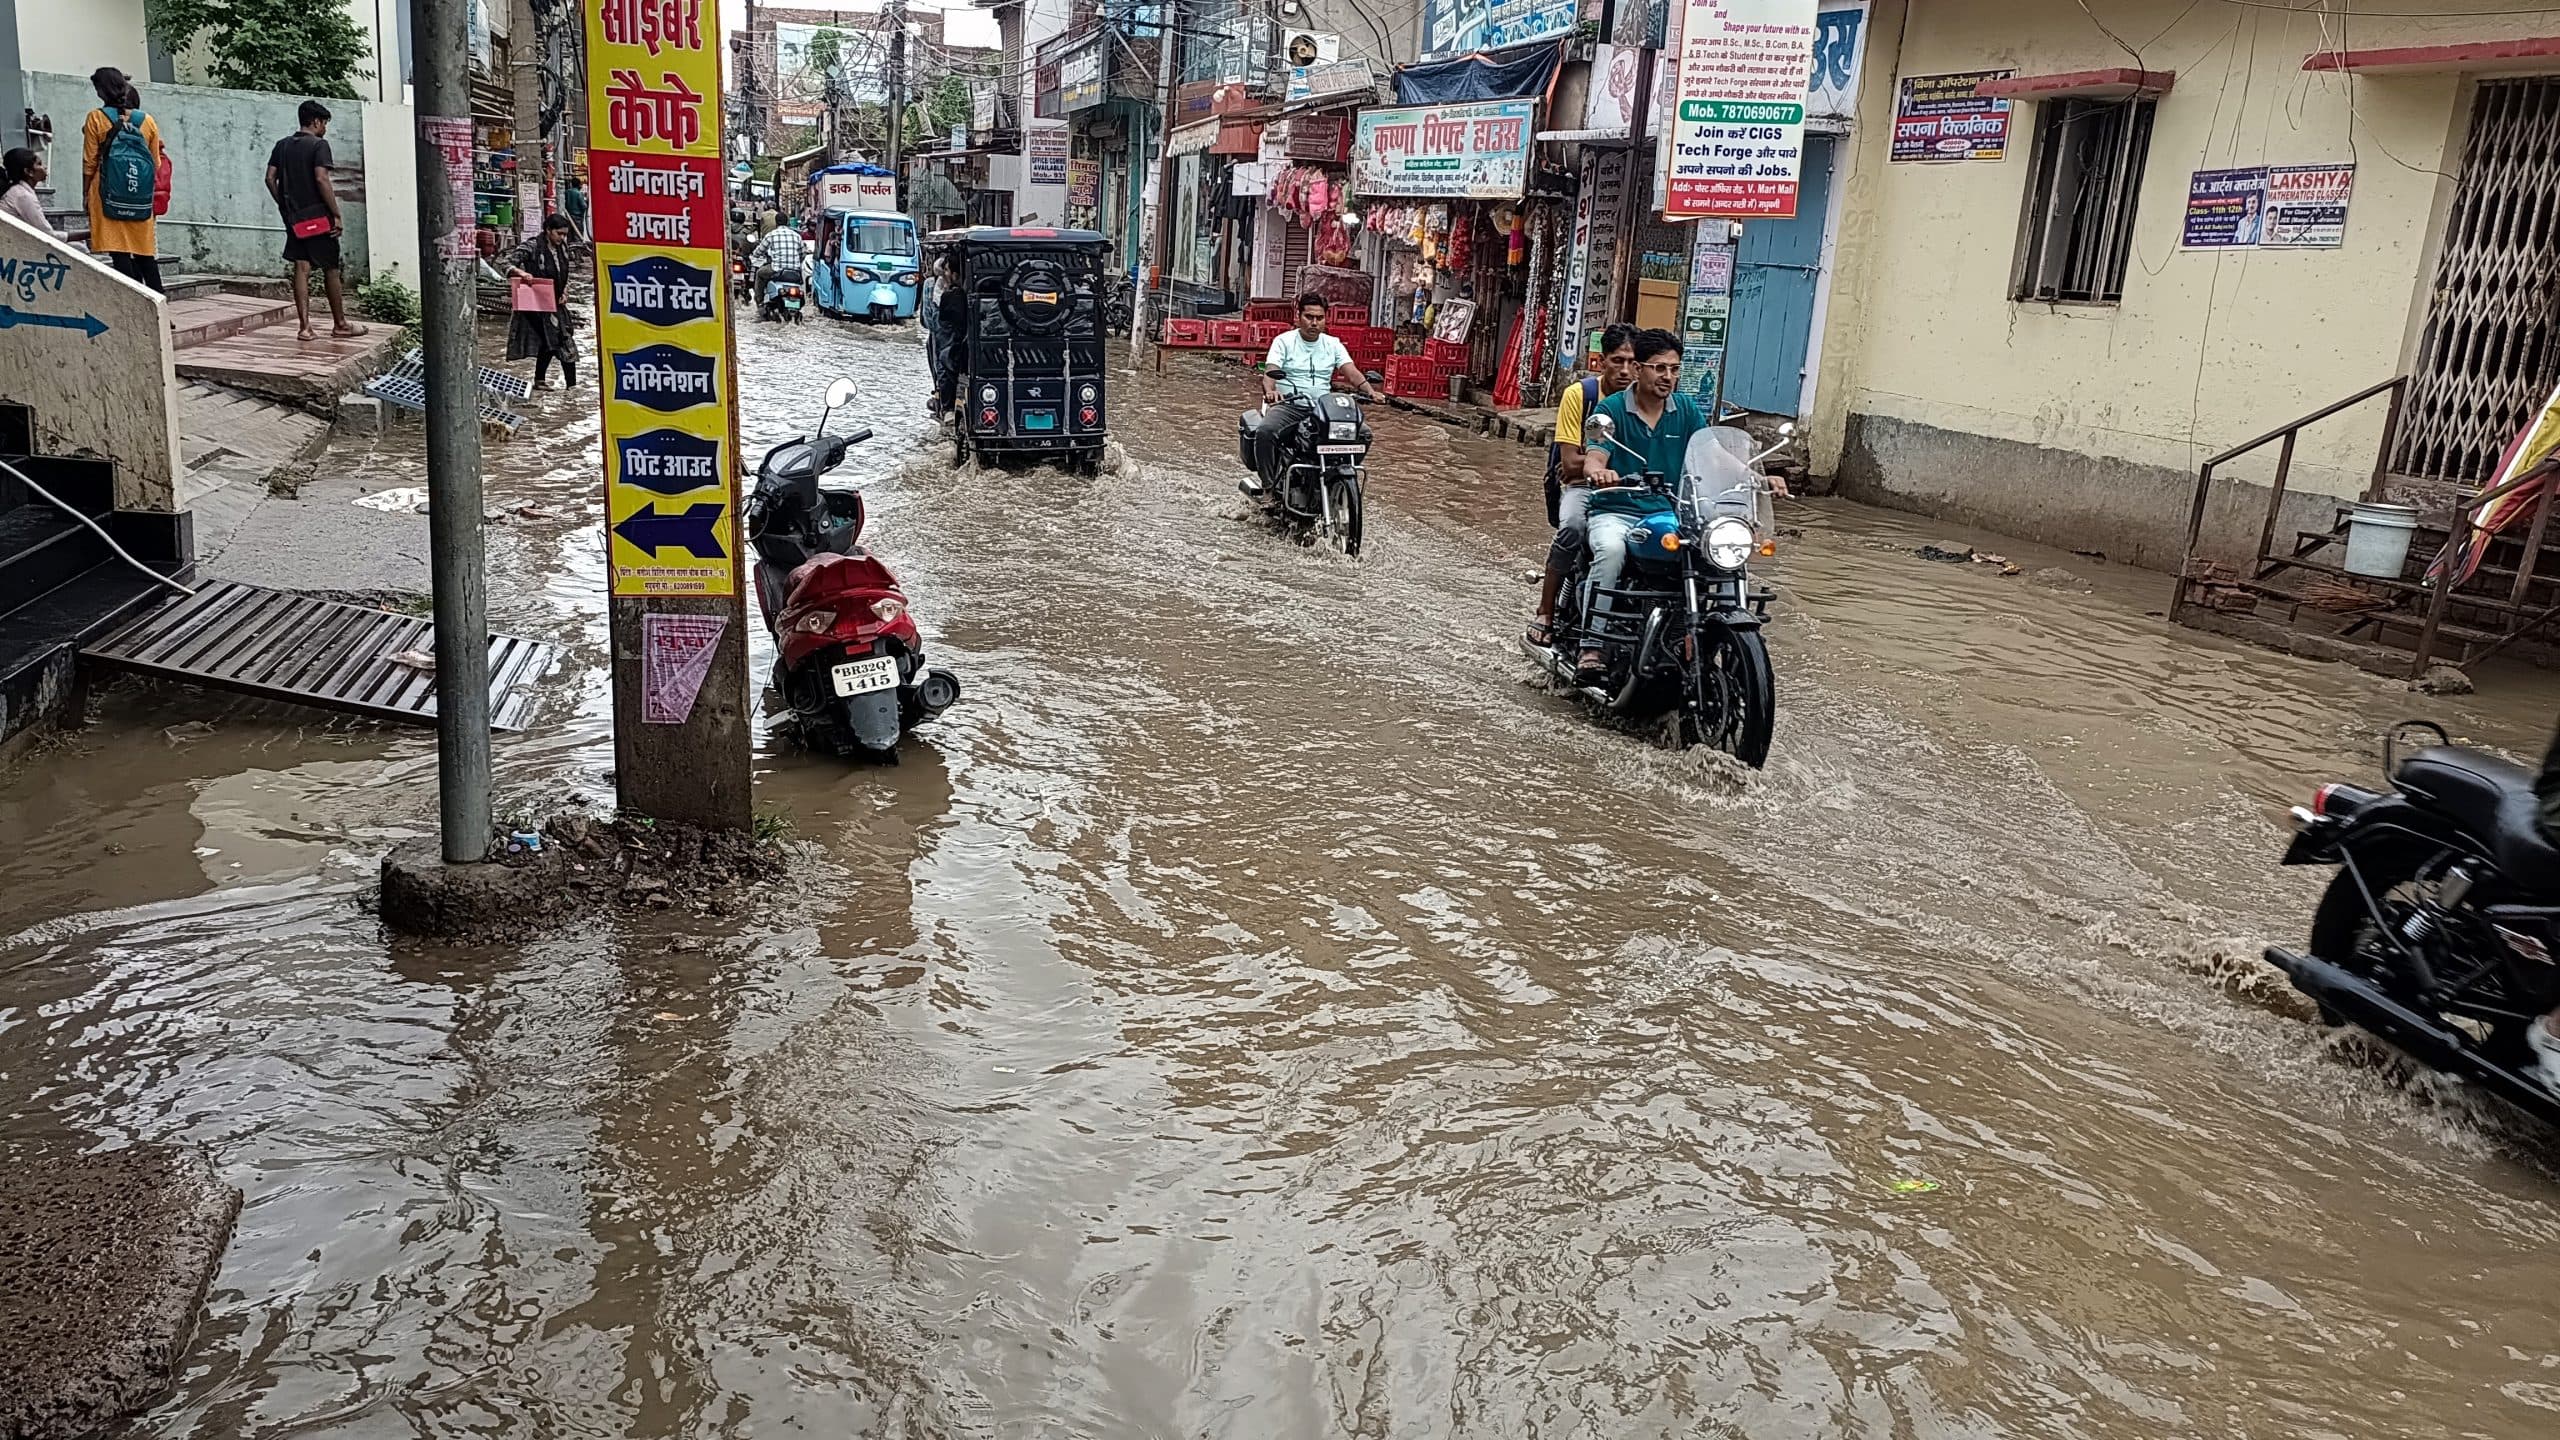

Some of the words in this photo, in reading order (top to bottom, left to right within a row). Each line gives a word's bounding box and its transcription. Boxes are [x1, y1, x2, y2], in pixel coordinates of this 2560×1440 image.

[1714, 10, 1727, 19] and
[1723, 21, 1745, 34] Shape
[1746, 24, 1762, 35] your
[1763, 24, 1784, 34] future
[1785, 25, 1799, 34] with
[1800, 26, 1811, 34] us.
[1729, 51, 1757, 61] Student
[1688, 63, 1700, 71] और
[1737, 64, 1746, 73] की
[1713, 77, 1729, 86] Tech
[1729, 78, 1748, 88] Forge
[1780, 79, 1792, 87] और
[1914, 78, 1935, 89] बिना
[1937, 76, 1980, 88] ऑपरेशन
[1745, 91, 1757, 99] और
[605, 69, 703, 151] कैफे
[1688, 104, 1717, 118] Mob.
[1722, 105, 1795, 120] 7870690677
[1694, 125, 1723, 139] Join
[1728, 128, 1747, 139] करें
[1749, 128, 1782, 140] CIGS
[1898, 121, 1939, 137] सपना
[1939, 114, 2005, 136] क्लिनिक
[1373, 123, 1418, 167] कृष्णा
[1422, 113, 1468, 155] गिफ्ट
[1472, 117, 1523, 153] हाउस
[1676, 143, 1710, 156] Tech
[1714, 144, 1752, 160] Forge
[1756, 146, 1776, 158] और
[1071, 160, 1099, 171] सिमरन
[1676, 163, 1704, 174] अपने
[1706, 163, 1735, 176] सपनो
[1738, 164, 1752, 176] की
[1756, 164, 1792, 177] Jobs.
[127, 162, 139, 193] safar
[608, 160, 704, 200] ऑनलाईन
[2269, 172, 2350, 190] LAKSHYA
[829, 183, 852, 195] डाक
[860, 181, 892, 195] पार्सल
[1747, 184, 1755, 194] V.
[1757, 184, 1776, 194] Mart
[1777, 184, 1794, 194] Mall
[2192, 182, 2207, 194] S.R.
[2268, 189, 2315, 201] MATHEMATICS
[2316, 189, 2349, 201] CLASSES
[1692, 199, 1710, 208] सामने
[1758, 200, 1781, 212] मधुबनी
[2189, 207, 2210, 215] Class-
[2211, 206, 2226, 214] 11th
[2228, 205, 2243, 213] 12th
[626, 207, 692, 245] अप्लाई
[614, 275, 665, 311] फोटो
[669, 277, 708, 312] स्टेट
[1689, 307, 1726, 315] SCHOLARS
[621, 361, 710, 395] लेमिनेशन
[626, 448, 660, 477] प्रिंट
[663, 455, 713, 478] आउट
[841, 660, 888, 678] BR32Q
[846, 674, 891, 692] 1415
